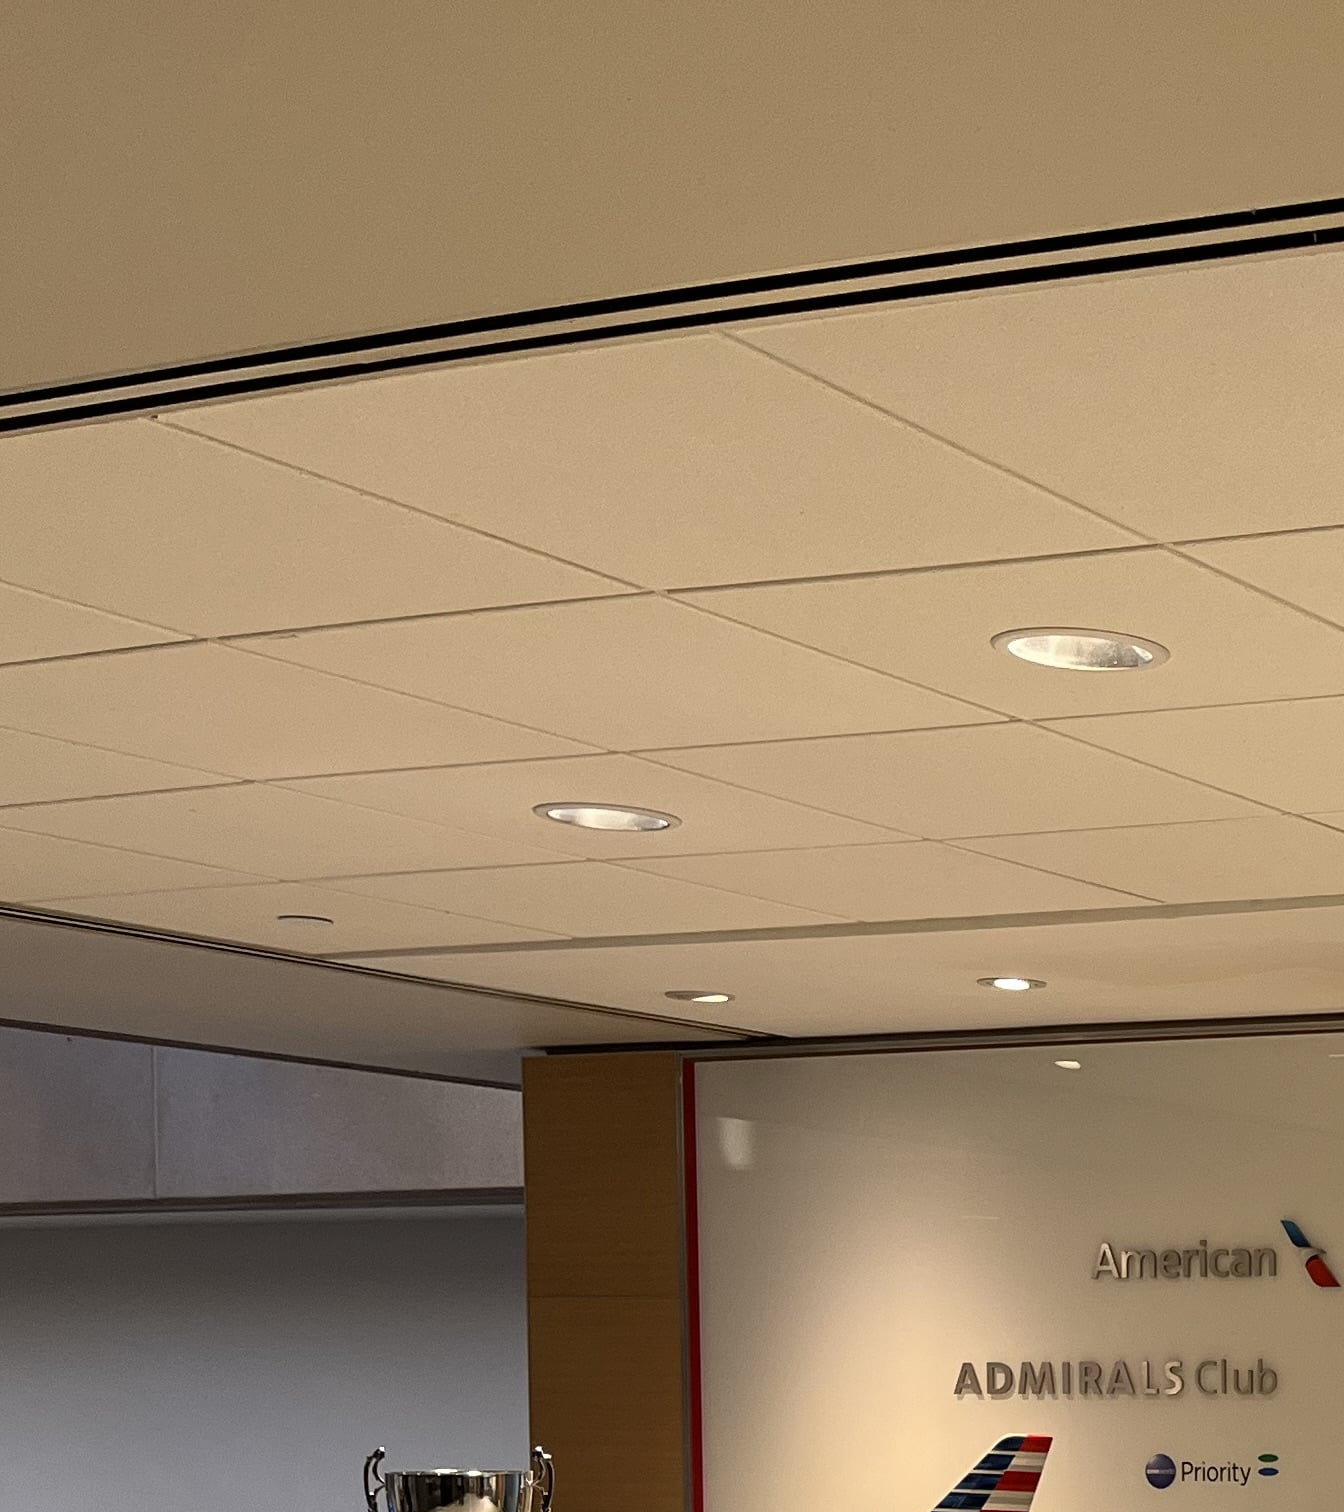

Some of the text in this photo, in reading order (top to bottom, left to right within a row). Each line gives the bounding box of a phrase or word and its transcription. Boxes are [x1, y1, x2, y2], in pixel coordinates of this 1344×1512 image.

[1091, 1240, 1278, 1280] American
[954, 1358, 1279, 1396] ADMIRALS Club
[1181, 1461, 1252, 1487] Priority
